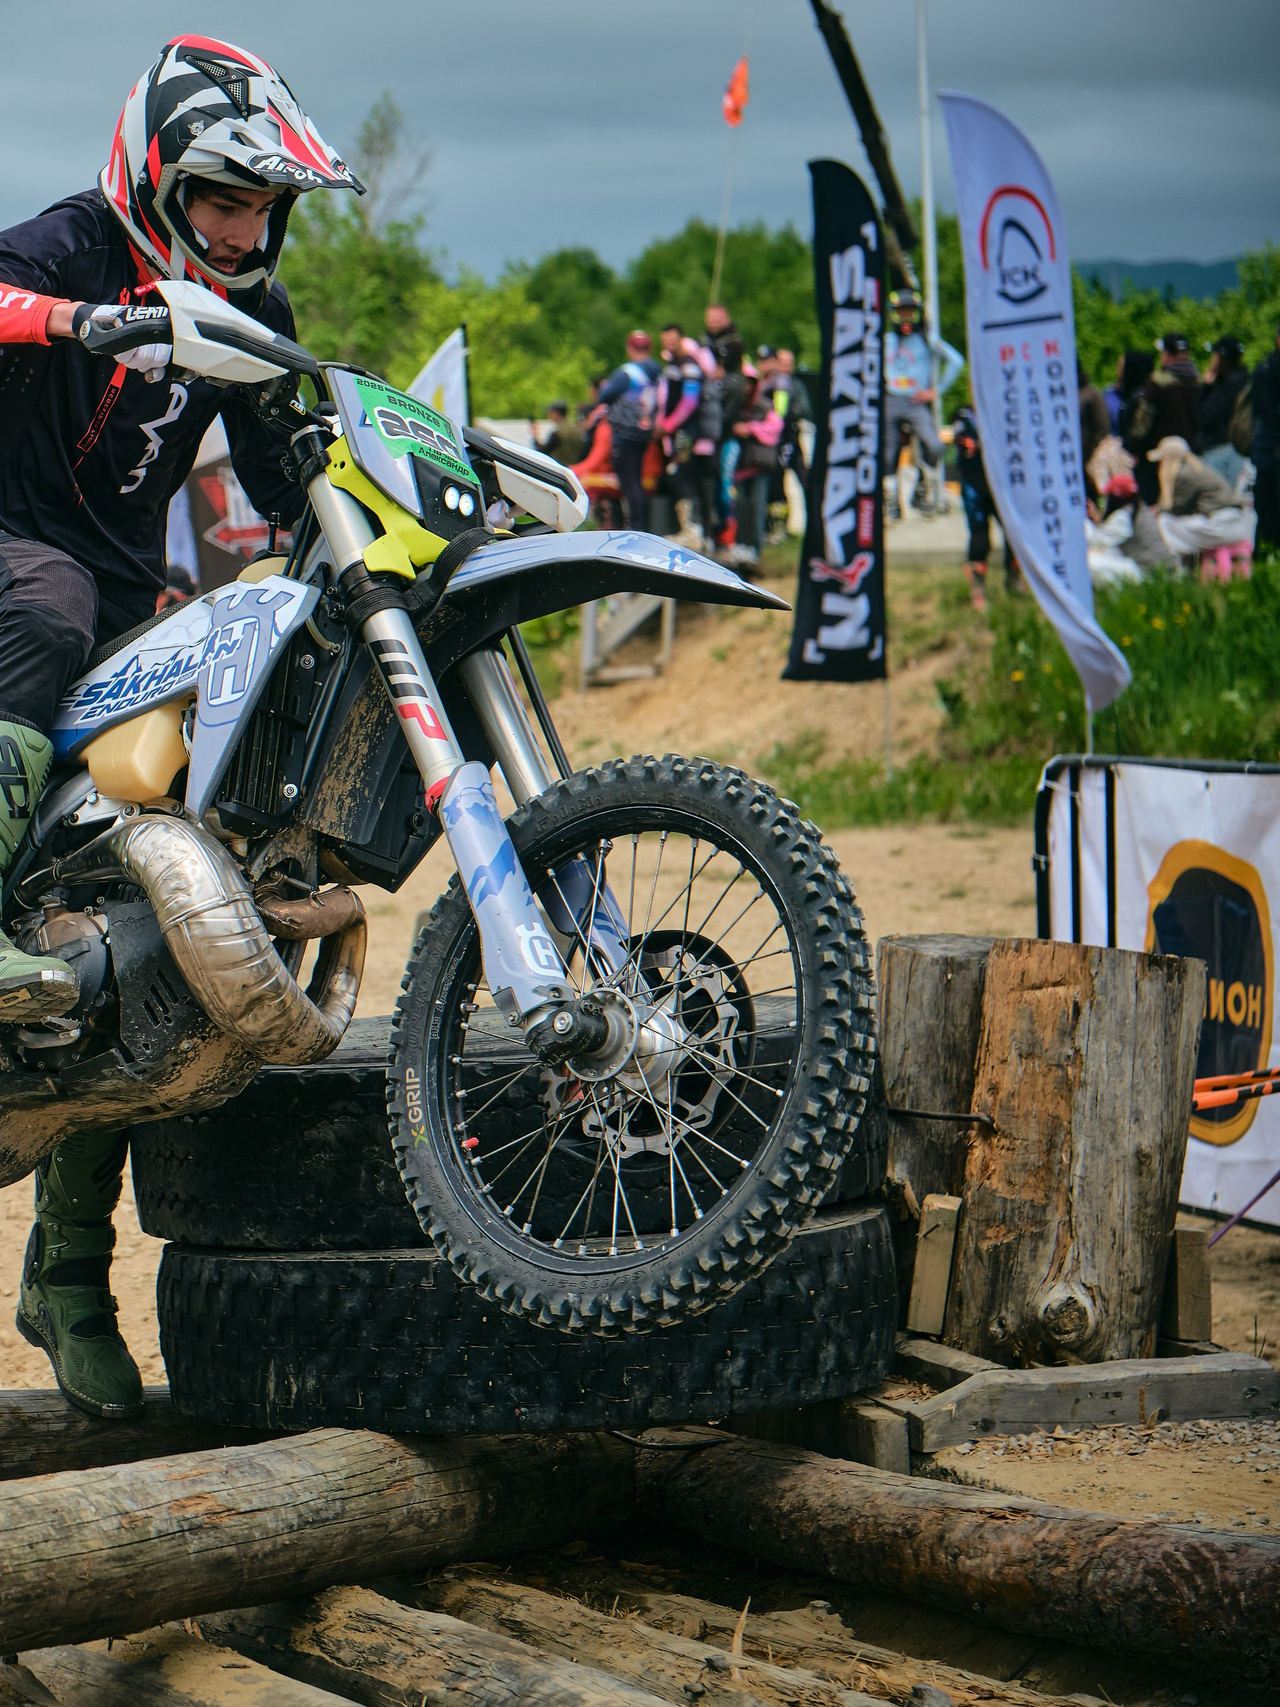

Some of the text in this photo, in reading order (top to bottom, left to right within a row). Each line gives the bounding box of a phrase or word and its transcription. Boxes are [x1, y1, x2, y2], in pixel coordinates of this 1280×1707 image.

[254, 156, 323, 183] Airoh
[856, 276, 881, 494] ENDURO
[418, 447, 470, 476] Александр
[818, 245, 870, 650] SAKHALIN
[79, 681, 177, 721] ENDURO
[1202, 977, 1262, 1029] ИОН
[405, 1067, 428, 1148] X-GRIP
